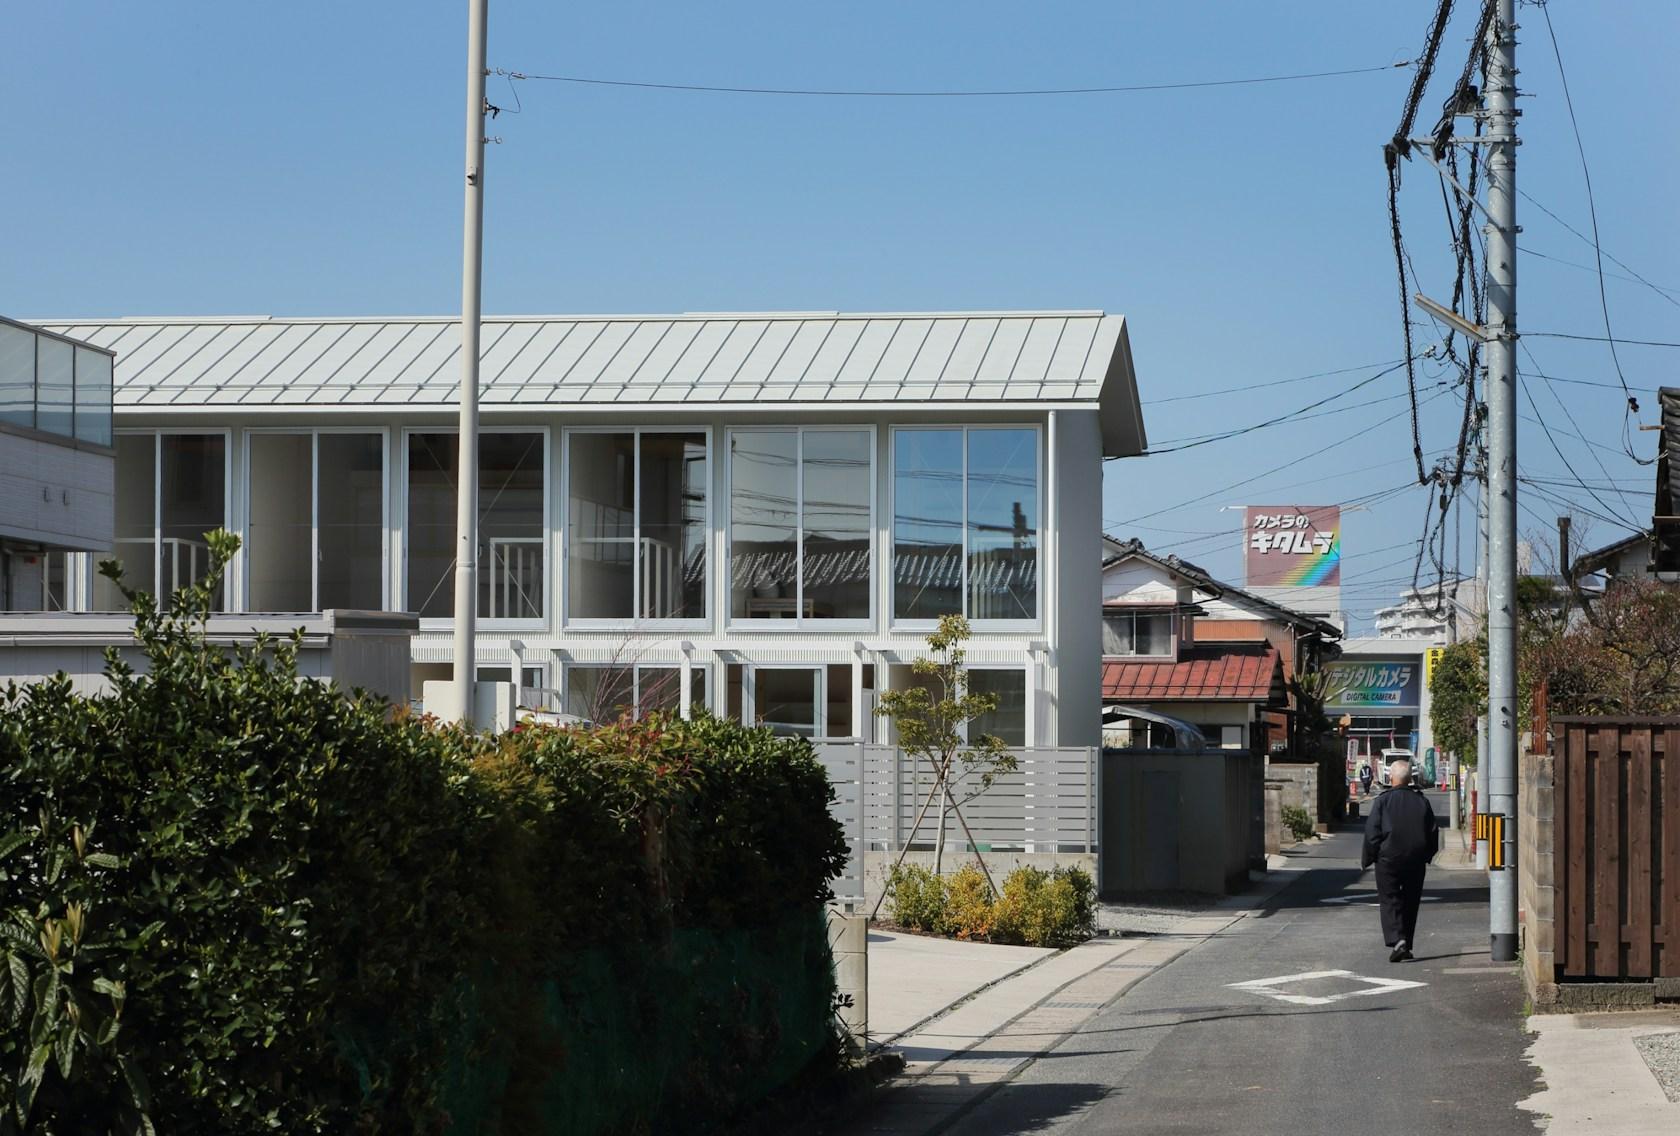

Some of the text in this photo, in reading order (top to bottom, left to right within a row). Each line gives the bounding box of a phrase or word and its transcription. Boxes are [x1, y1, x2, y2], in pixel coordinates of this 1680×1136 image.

[1253, 514, 1310, 529] カメラの
[1251, 530, 1334, 555] キタムラ
[1331, 666, 1412, 689] デジタルカメラ
[1346, 692, 1397, 702] DIGITAL CAMERA
